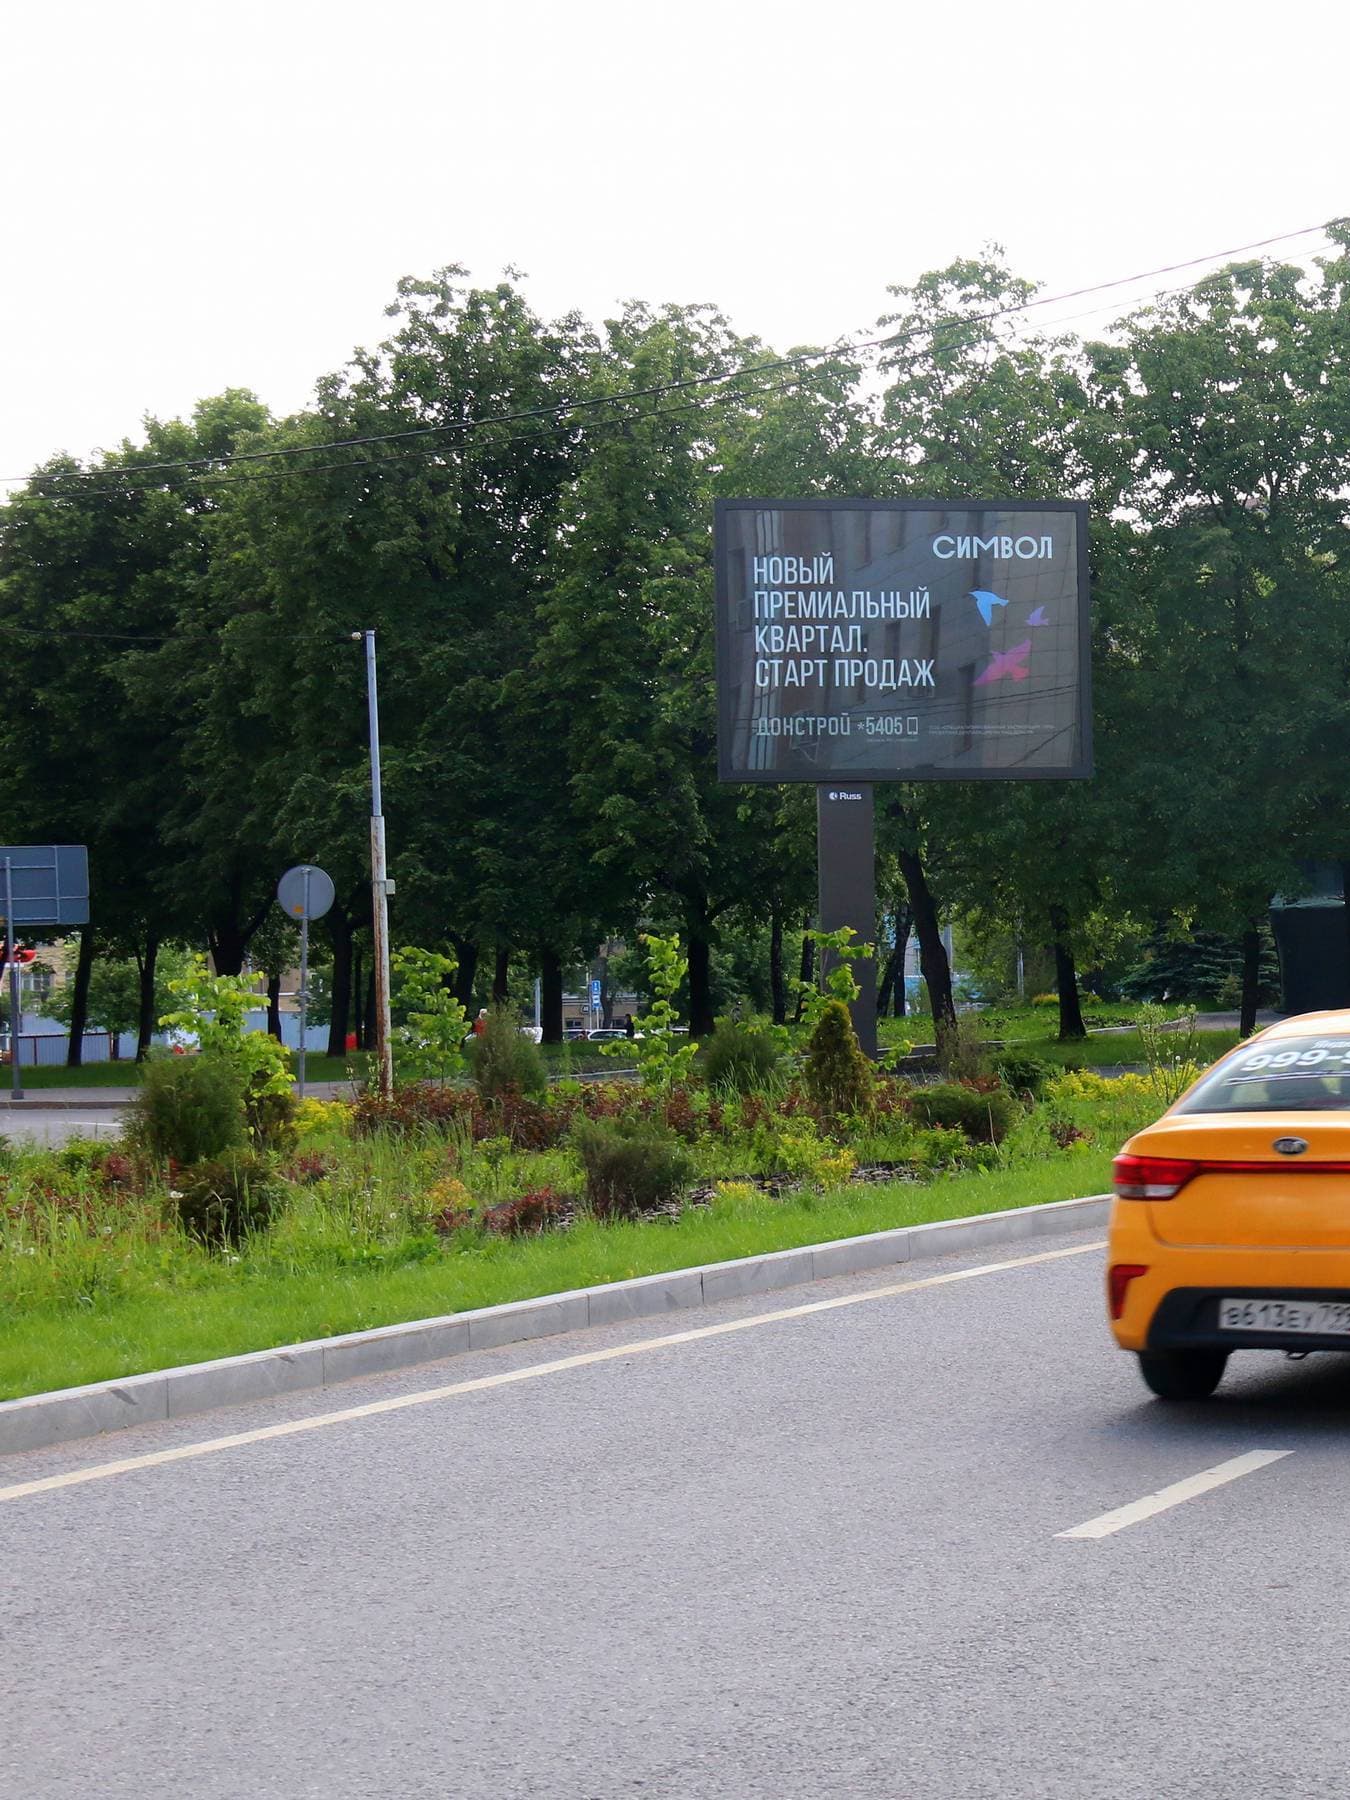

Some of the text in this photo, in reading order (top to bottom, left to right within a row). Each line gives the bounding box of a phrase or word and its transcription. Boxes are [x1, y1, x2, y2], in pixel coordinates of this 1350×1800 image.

[932, 536, 1053, 559] СИМВОЛ
[753, 552, 834, 585] НОВЫЙ
[753, 586, 931, 619] ПРЕМИАЛЬНЫЙ
[755, 625, 868, 653] КВАРТАЛ.
[755, 659, 936, 690] СТАРТ ПРОДАЖ
[757, 713, 850, 736] ДОНСТРОЙ
[839, 791, 862, 800] Russ
